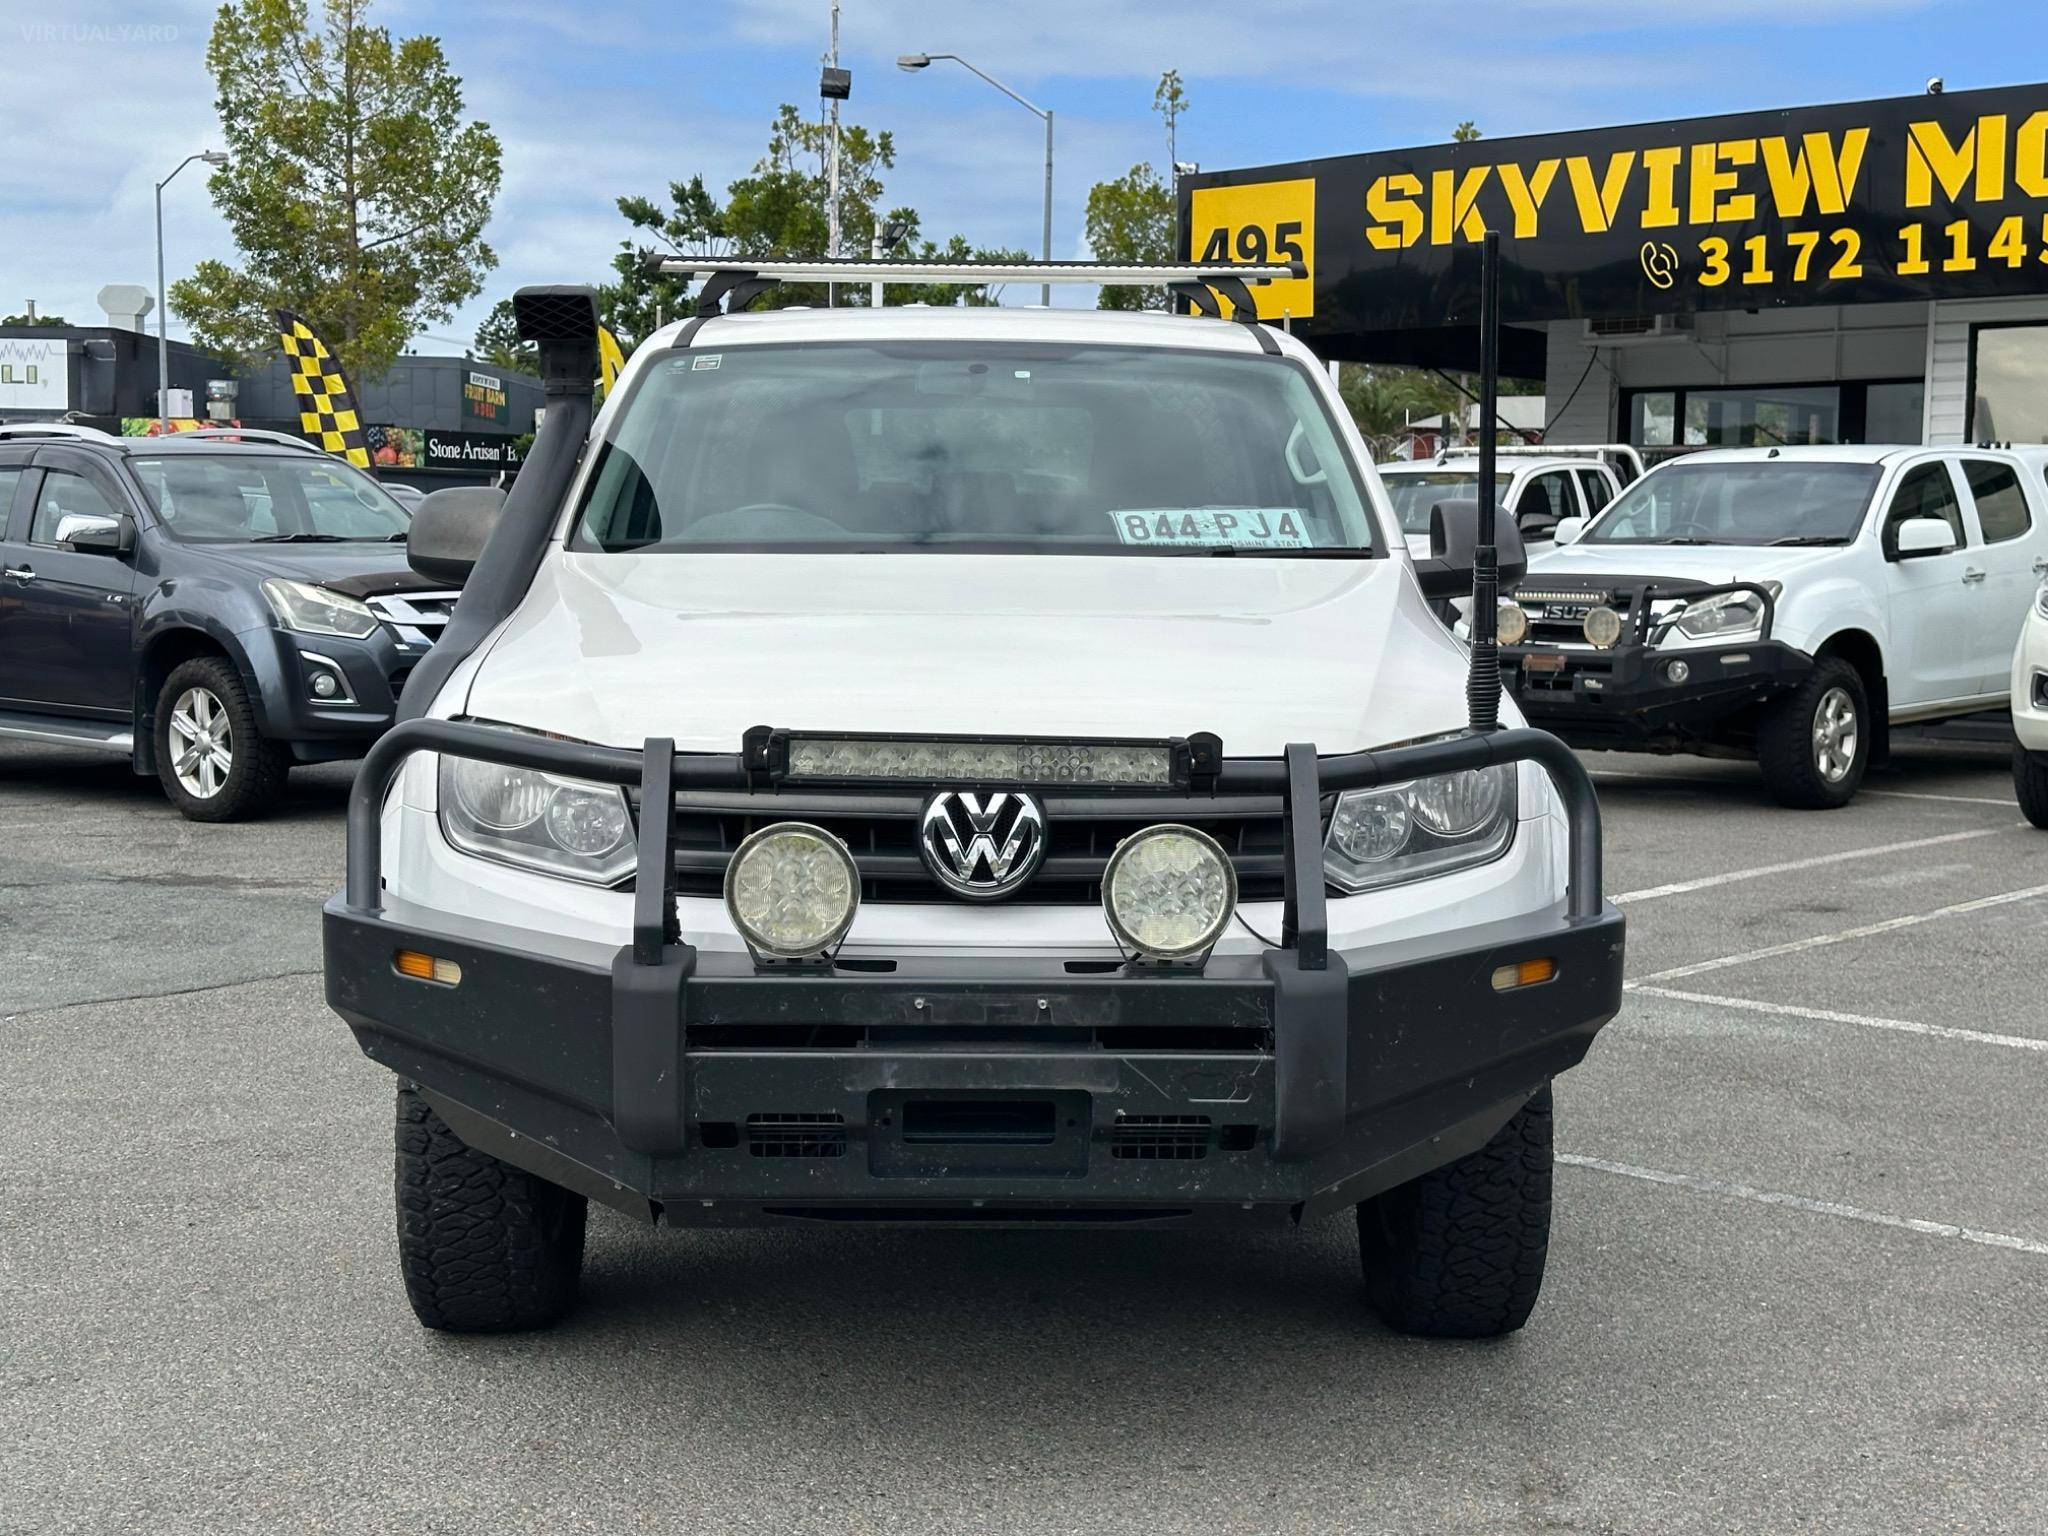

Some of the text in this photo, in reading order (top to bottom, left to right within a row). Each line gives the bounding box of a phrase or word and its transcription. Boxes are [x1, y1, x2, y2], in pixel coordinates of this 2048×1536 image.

[1366, 127, 1870, 250] SKYVIEW
[1200, 221, 1303, 263] 495
[1698, 213, 2048, 287] 3172 114
[429, 438, 460, 459] Stone
[1544, 605, 1590, 619] ISUZ
